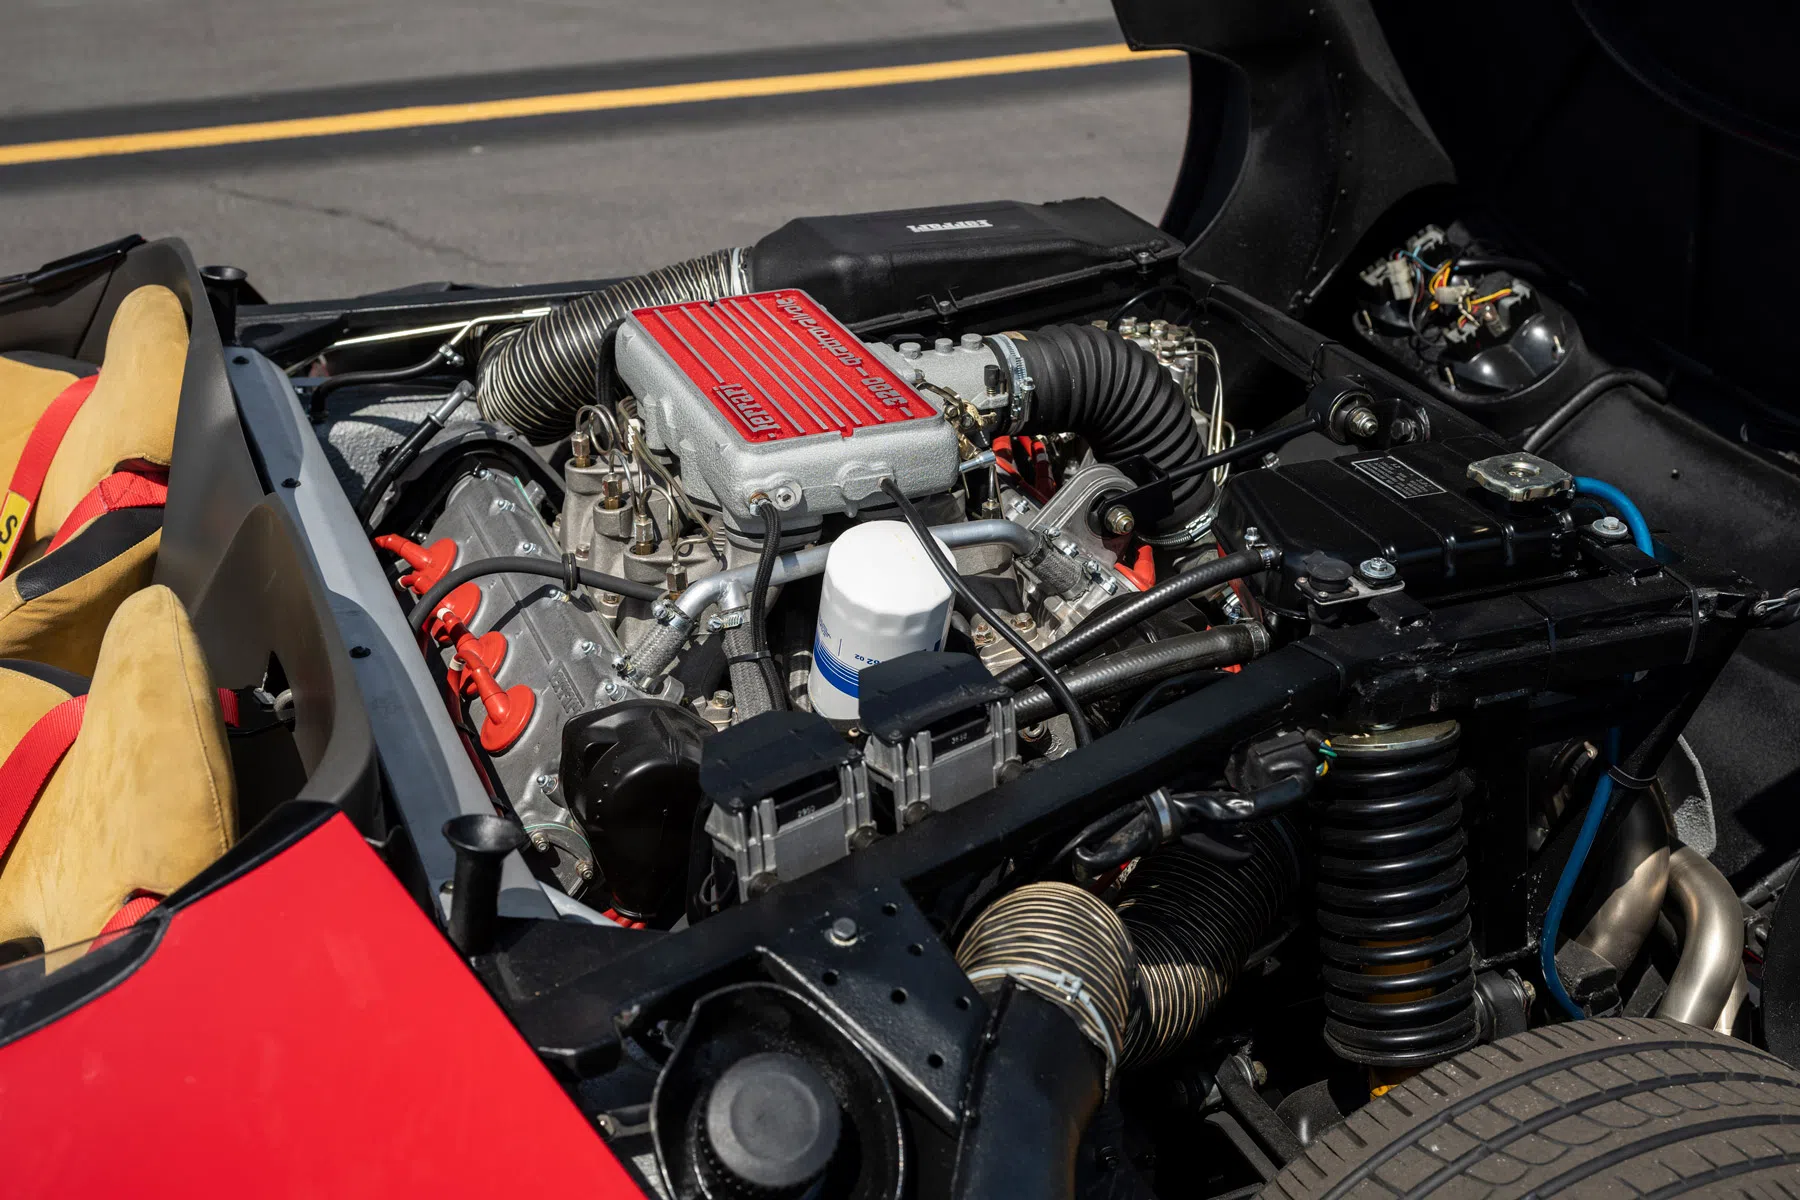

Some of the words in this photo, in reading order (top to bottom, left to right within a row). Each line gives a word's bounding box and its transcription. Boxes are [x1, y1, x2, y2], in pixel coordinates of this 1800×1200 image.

[776, 297, 862, 367] quattrovalvole
[713, 383, 781, 432] Ferrari
[861, 377, 908, 406] 3200
